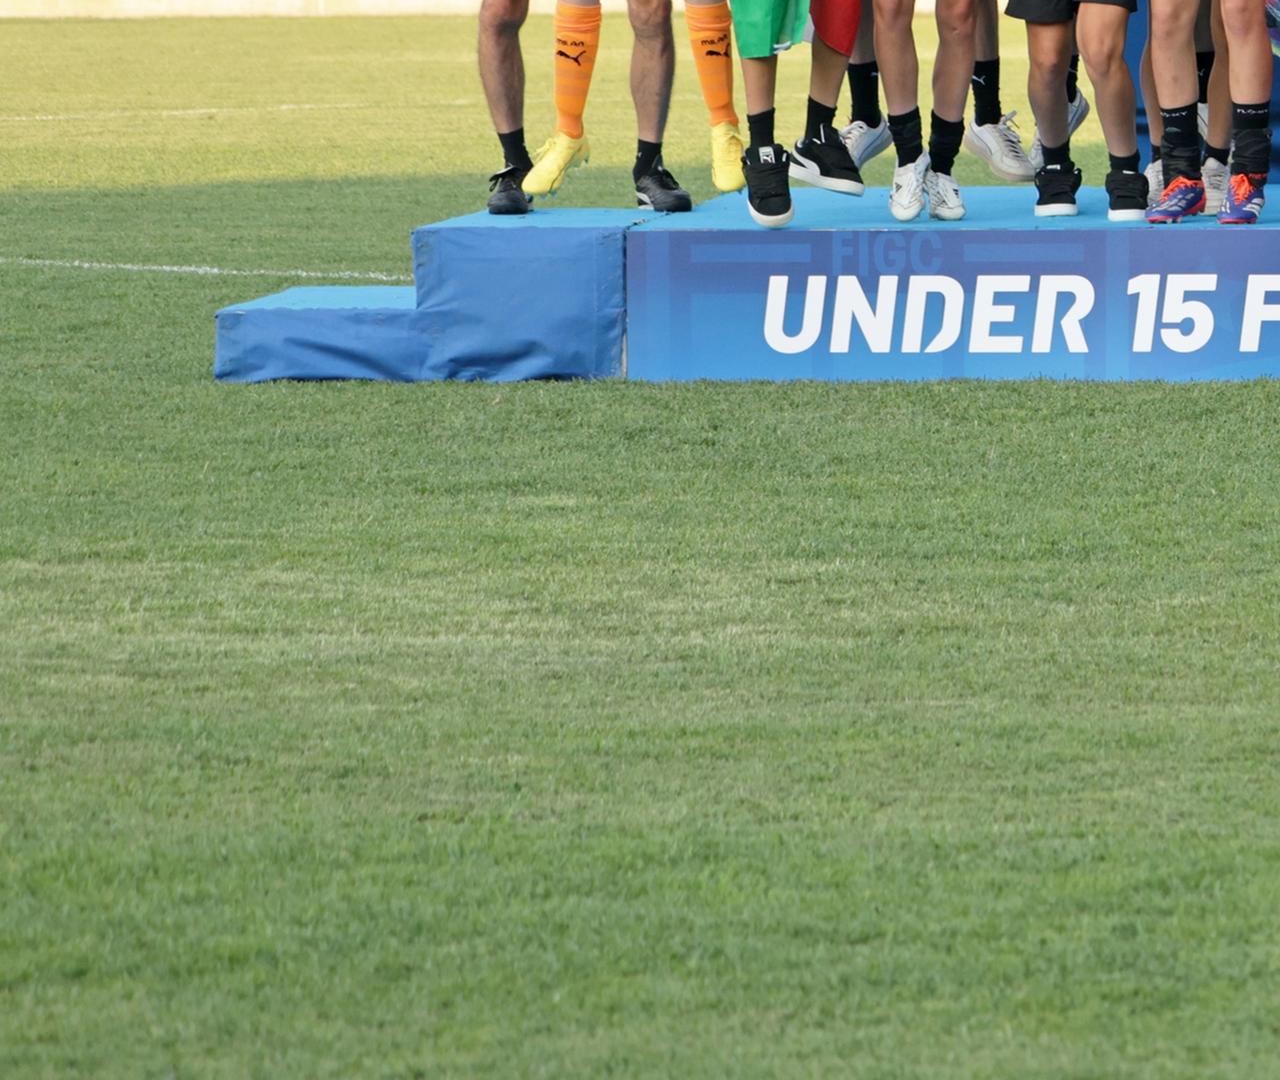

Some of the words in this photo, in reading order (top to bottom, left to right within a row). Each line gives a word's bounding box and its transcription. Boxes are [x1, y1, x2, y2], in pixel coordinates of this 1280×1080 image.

[831, 232, 943, 276] FIGC
[762, 274, 1097, 355] UNDER
[1125, 273, 1219, 353] 15
